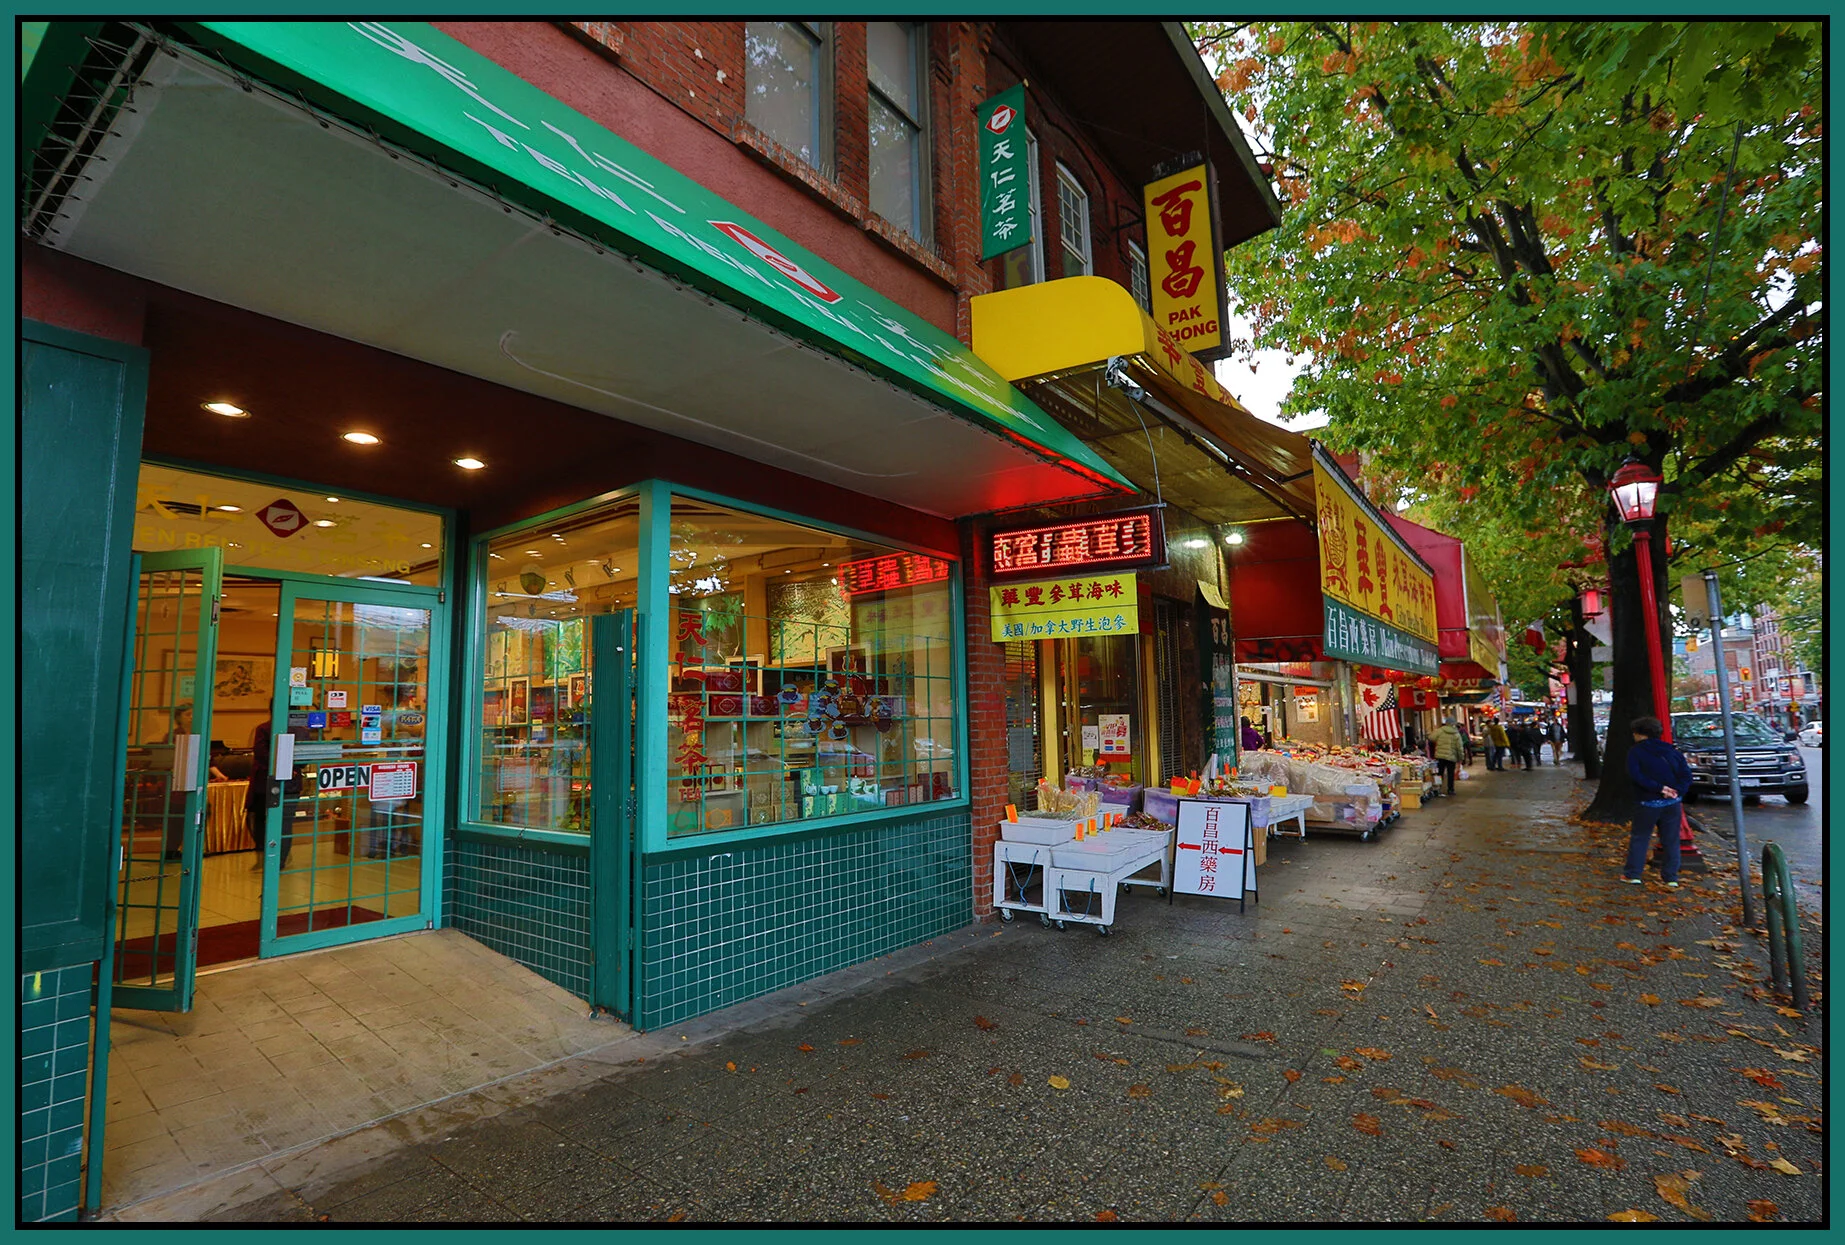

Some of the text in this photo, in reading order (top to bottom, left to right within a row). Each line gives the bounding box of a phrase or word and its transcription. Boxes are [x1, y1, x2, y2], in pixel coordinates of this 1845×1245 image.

[991, 139, 1018, 240] 天仁茗茶
[463, 111, 637, 215] TEN
[644, 209, 777, 290] REN
[773, 279, 877, 343] TEA
[873, 333, 914, 363] &
[1151, 179, 1204, 298] 百昌
[1168, 305, 1203, 325] PAK
[138, 526, 176, 546] EN
[675, 613, 709, 775] 天仁茗茶
[320, 766, 370, 789] OPEN
[678, 787, 702, 802] TEA
[1197, 806, 1221, 892] 百昌西藥房
